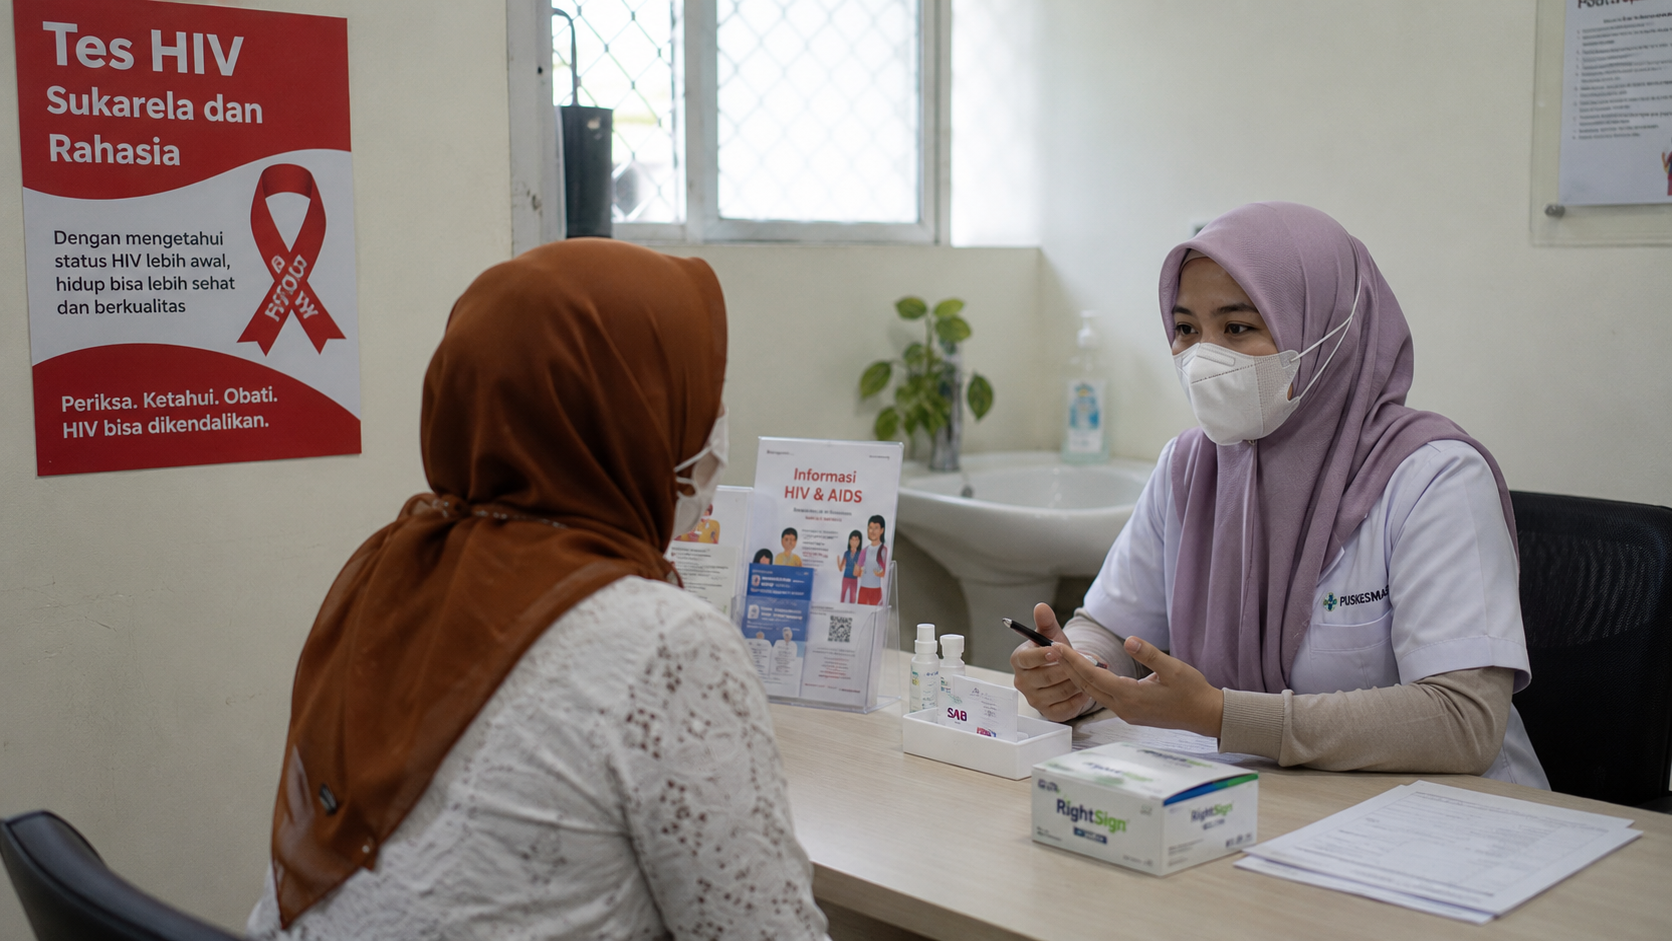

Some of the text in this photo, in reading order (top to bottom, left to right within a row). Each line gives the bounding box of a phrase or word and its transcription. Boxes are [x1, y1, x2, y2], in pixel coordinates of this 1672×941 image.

[42, 20, 245, 77] Tes HIV
[46, 85, 263, 124] Sukarela dan
[49, 133, 181, 166] Rahasia
[53, 230, 224, 249] Dengan mengetahui
[55, 252, 231, 271] status HIV lebih awal,
[56, 275, 236, 295] hidup bisa lebih sehat
[57, 298, 186, 315] dan berkualitas
[61, 386, 278, 412] Periksa. Ketahui. Obati.
[62, 413, 270, 439] HIV bisa dikendalikan.
[793, 467, 857, 484] Informasi
[784, 485, 863, 504] HIV & AIDS
[1056, 798, 1127, 834] RightSign
